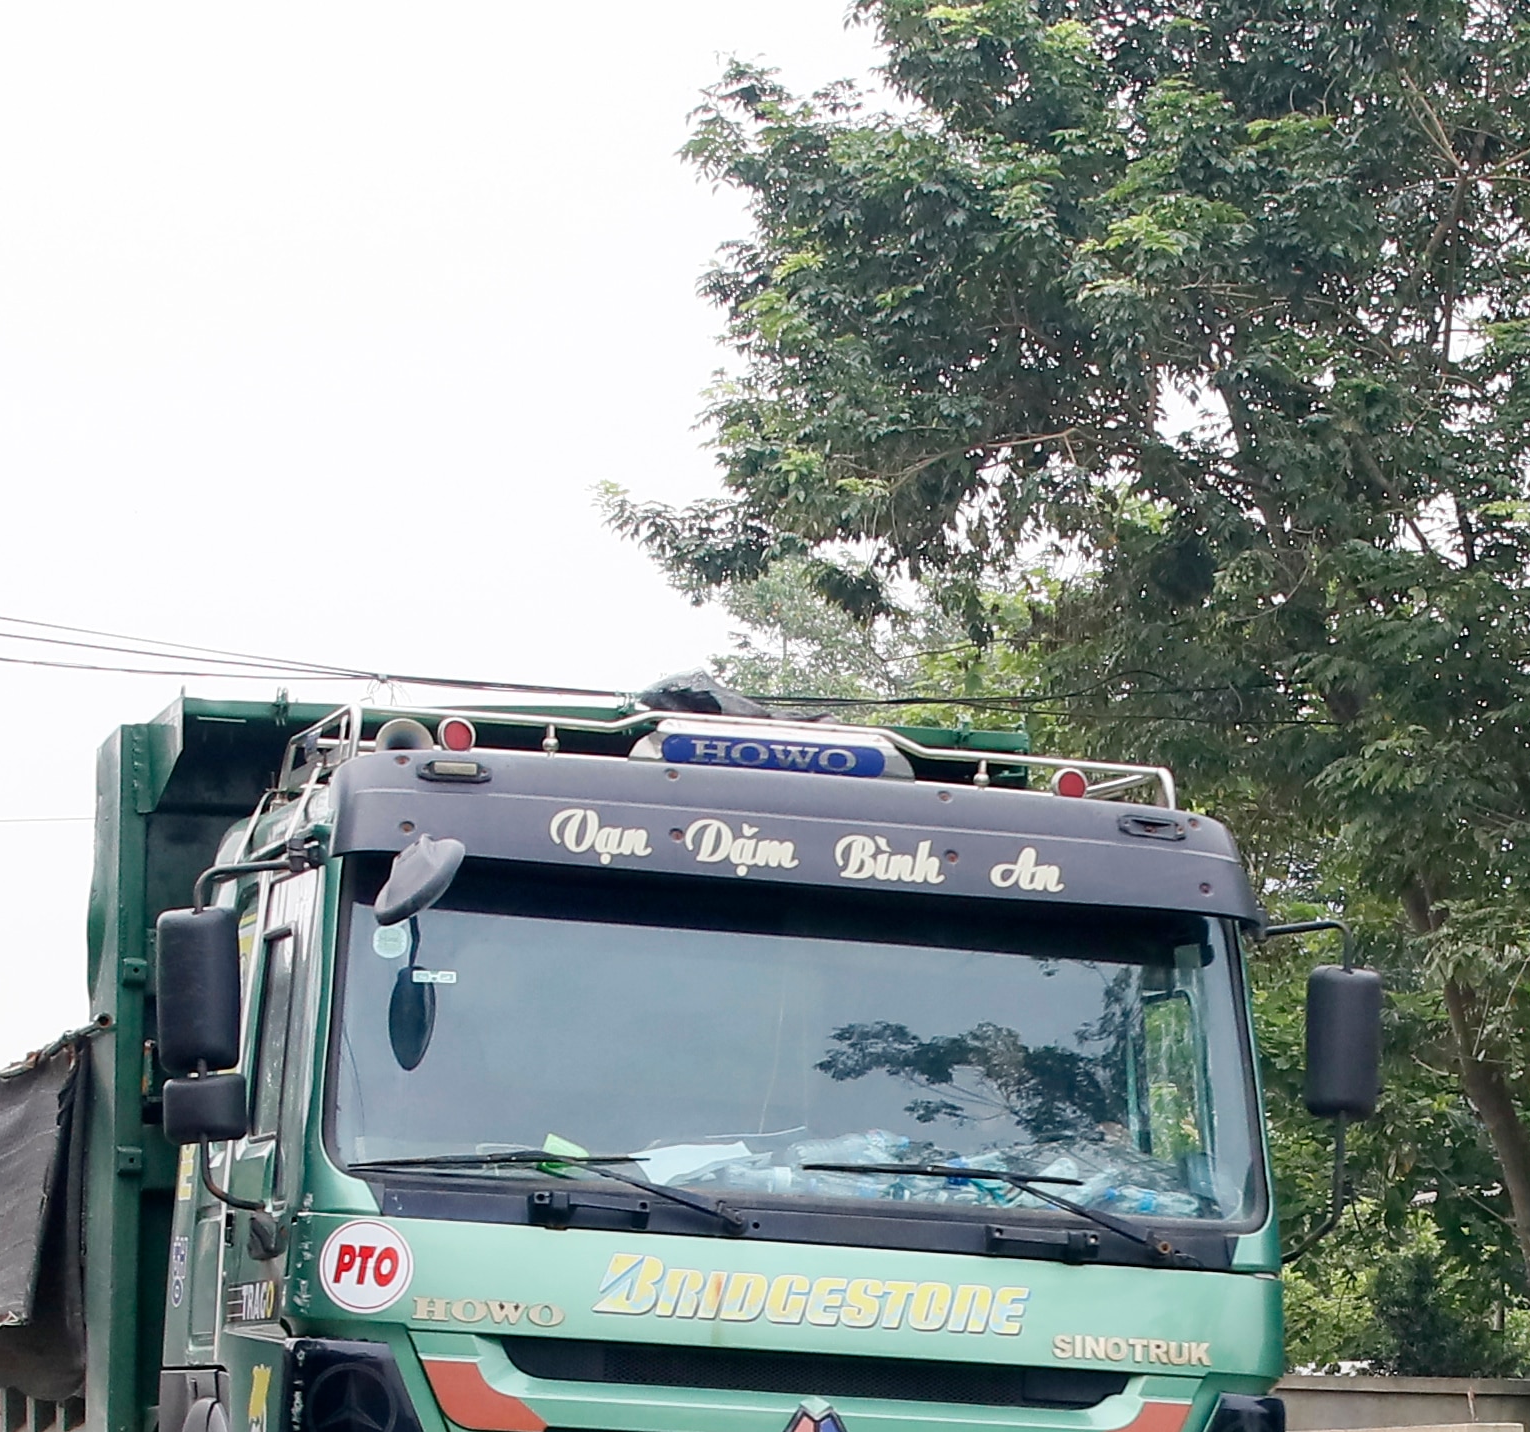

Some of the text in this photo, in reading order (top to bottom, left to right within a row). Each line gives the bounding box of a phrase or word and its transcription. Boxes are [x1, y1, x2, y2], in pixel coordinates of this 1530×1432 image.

[690, 738, 858, 773] HOWO
[549, 808, 1065, 893] Vạn Dặm Bình An
[332, 1243, 400, 1288] PTO
[411, 1296, 566, 1328] HOWO
[591, 1252, 1030, 1336] BRIDGESTONE
[1052, 1334, 1212, 1368] SINOTRUK
